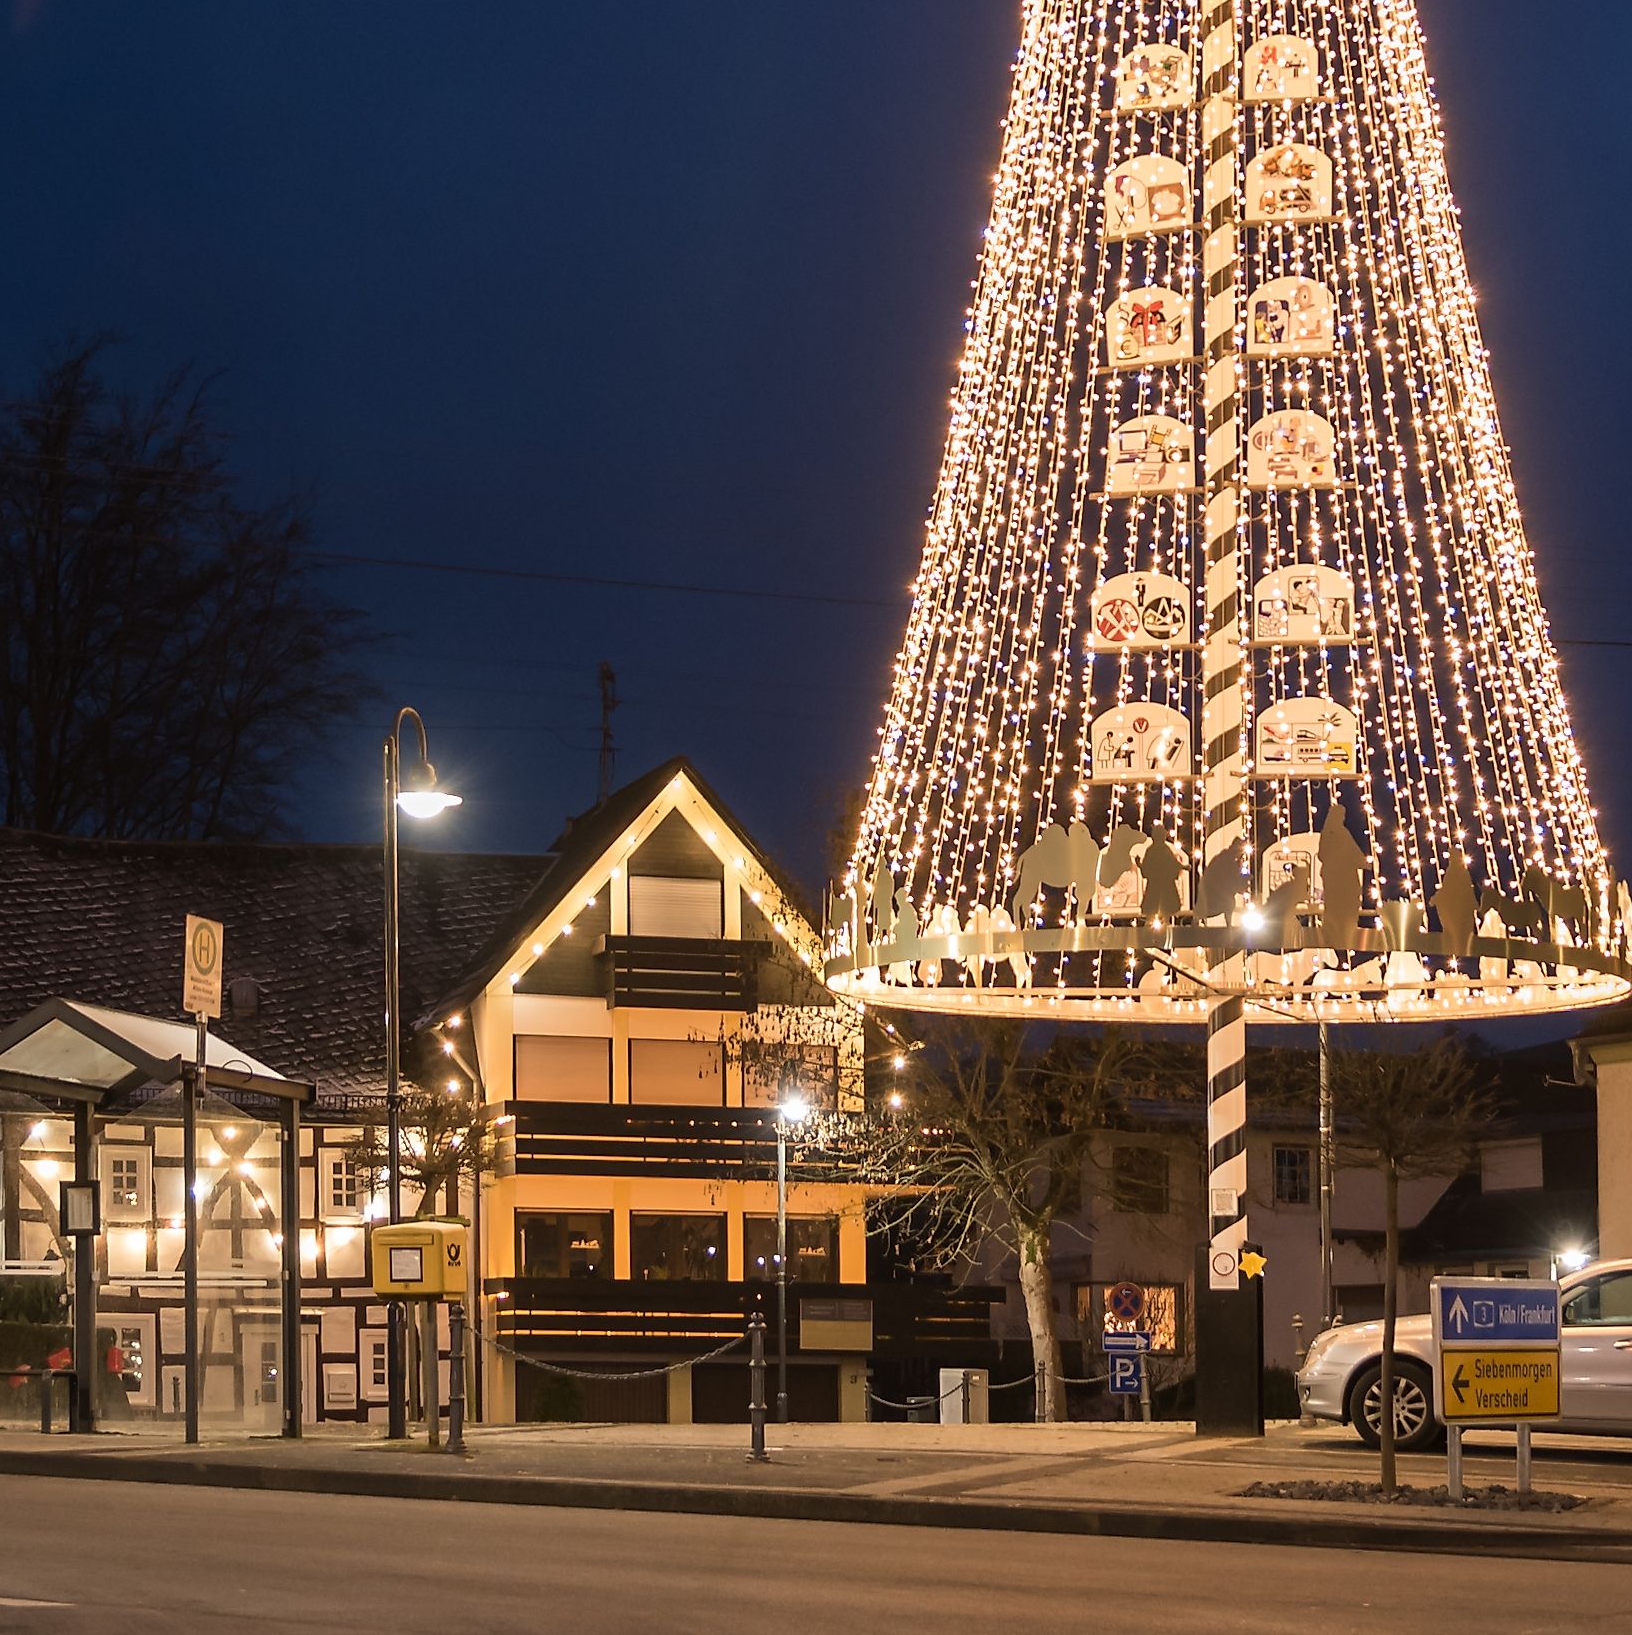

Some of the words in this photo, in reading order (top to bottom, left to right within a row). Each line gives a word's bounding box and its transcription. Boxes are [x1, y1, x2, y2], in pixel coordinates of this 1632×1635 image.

[199, 932, 210, 965] H
[1115, 1358, 1135, 1388] P
[1474, 1358, 1552, 1383] Siebenmorgen
[1475, 1388, 1528, 1408] Verscheid
